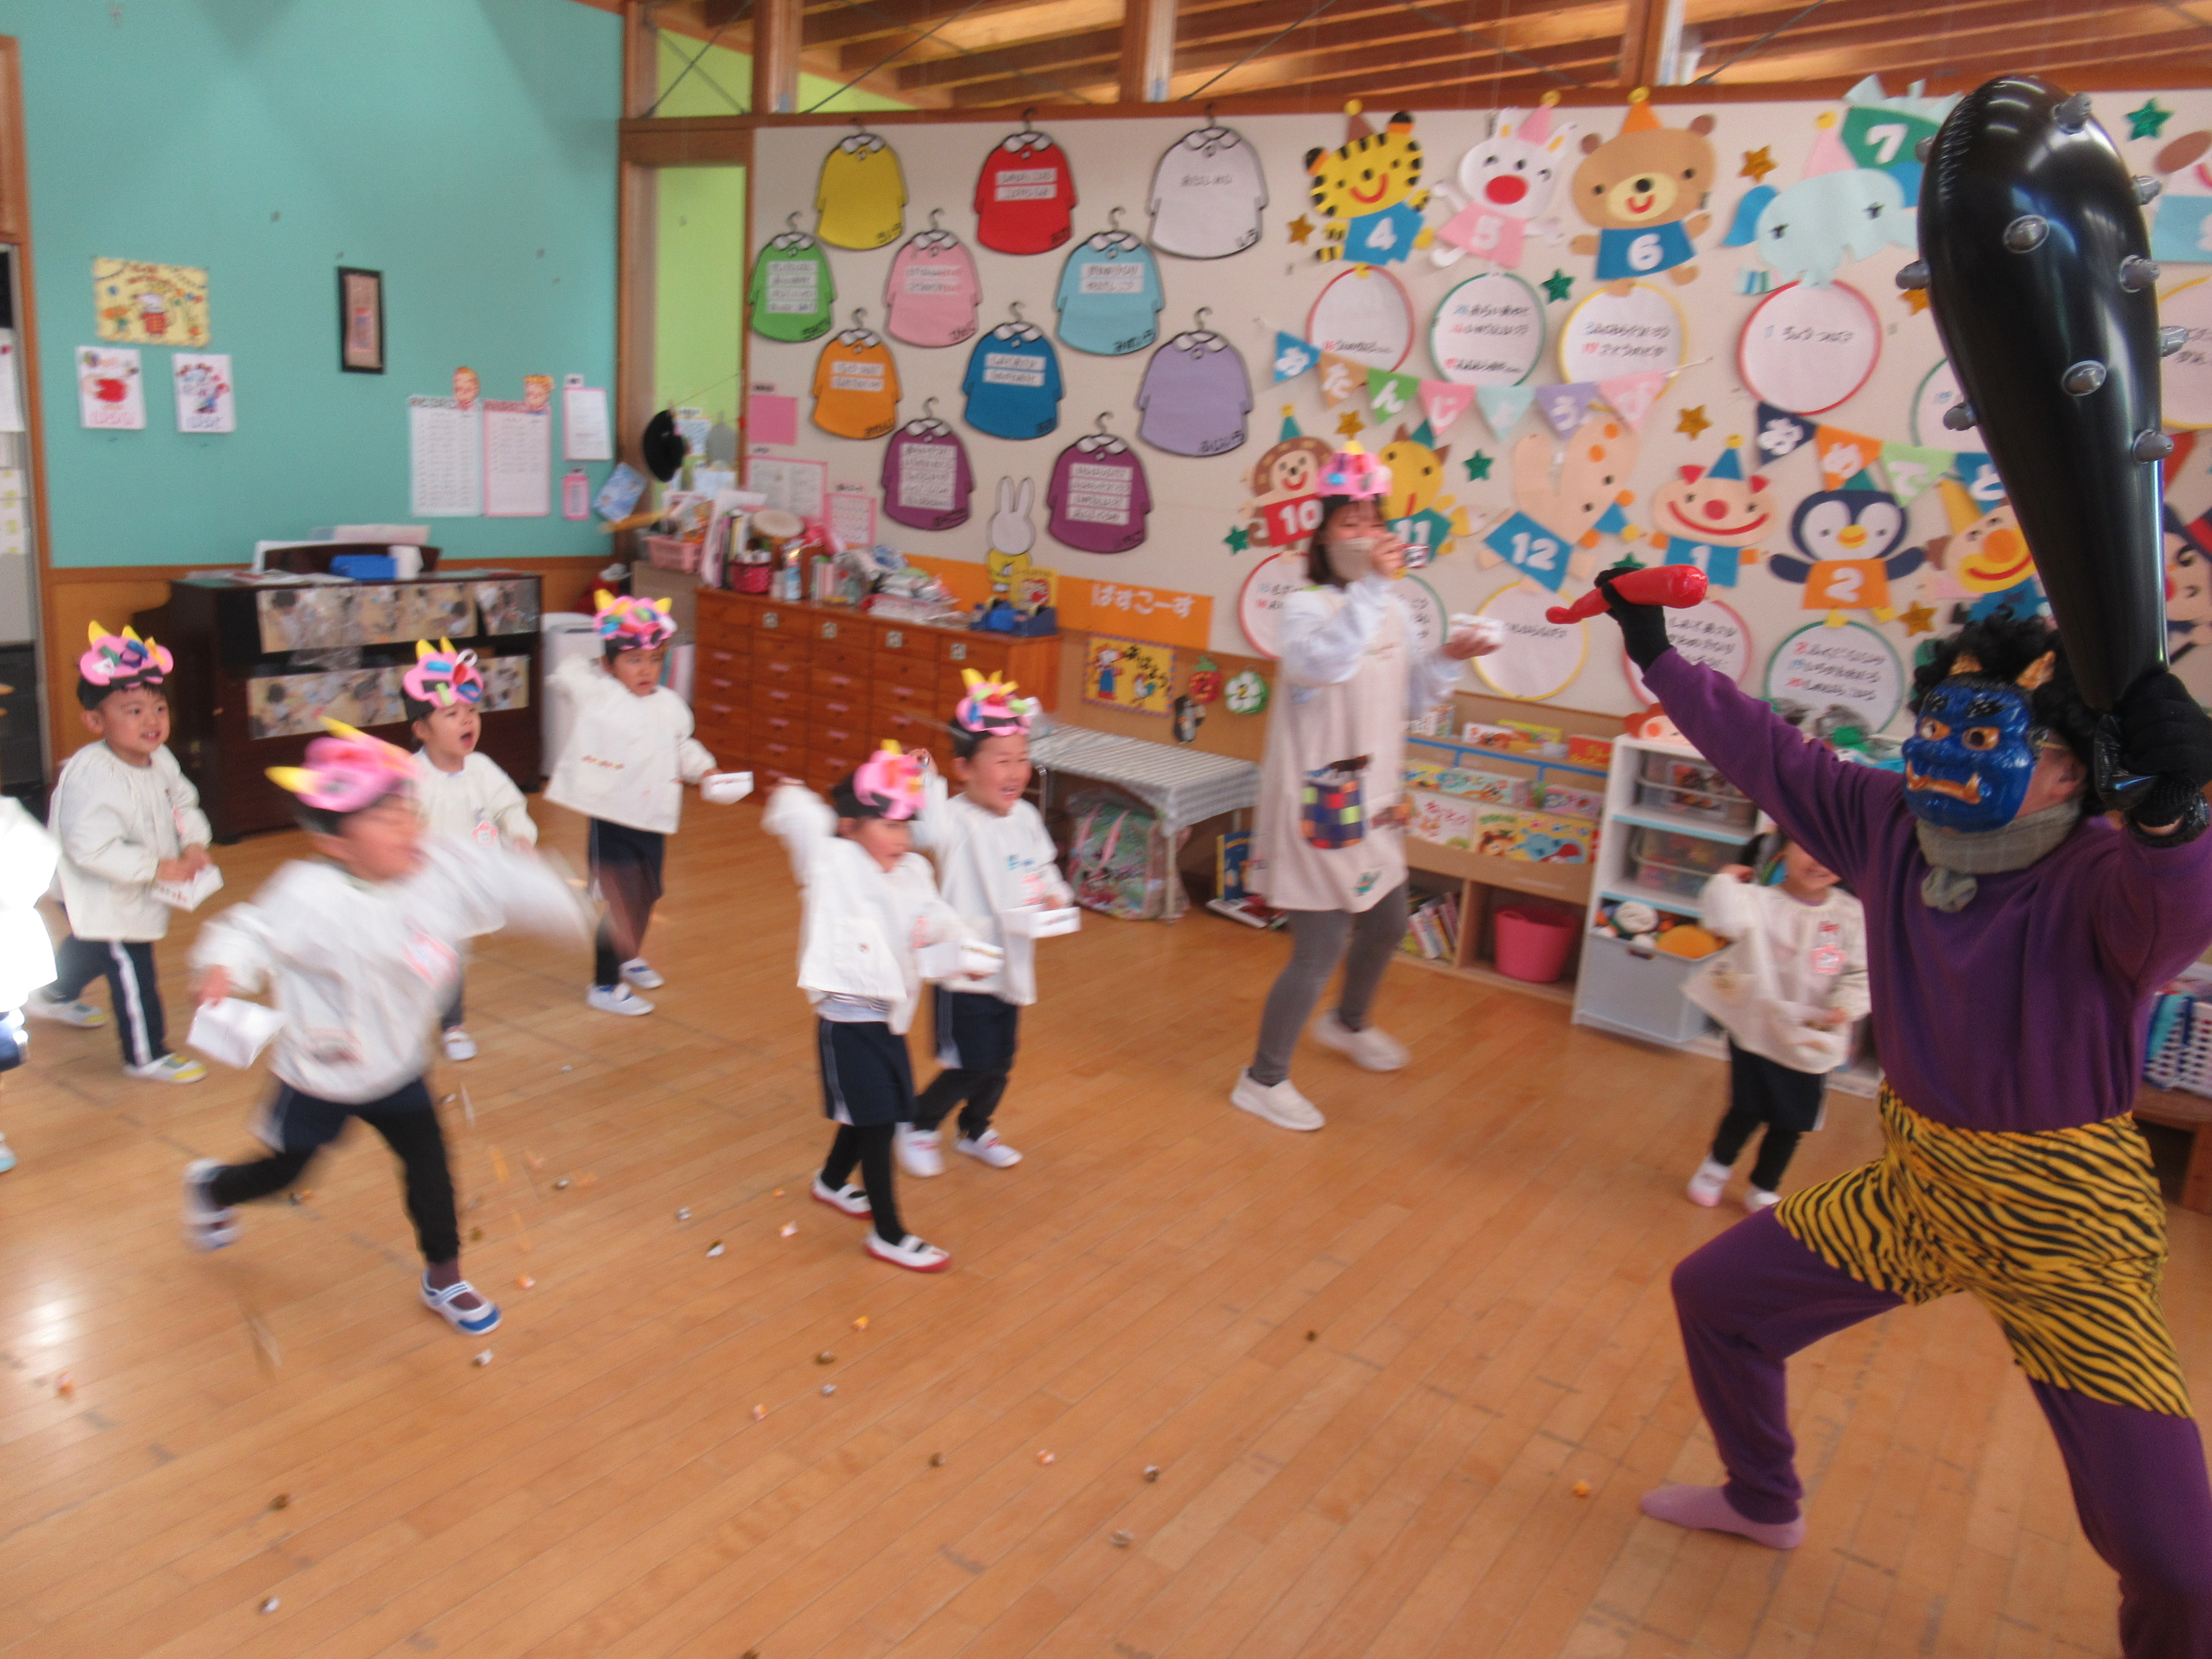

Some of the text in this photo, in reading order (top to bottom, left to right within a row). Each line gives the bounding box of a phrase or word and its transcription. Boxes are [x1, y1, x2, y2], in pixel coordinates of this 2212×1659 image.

[1866, 123, 1908, 163] 7
[1365, 217, 1398, 250] 4
[1471, 214, 1505, 250] 5
[1626, 233, 1664, 271] 6
[1278, 498, 1324, 536] 10
[1393, 519, 1432, 544] 11
[1511, 532, 1560, 571] 12
[1689, 544, 1712, 568] 1
[1091, 583, 1197, 619] ばすこーす
[1825, 567, 1865, 603] 2
